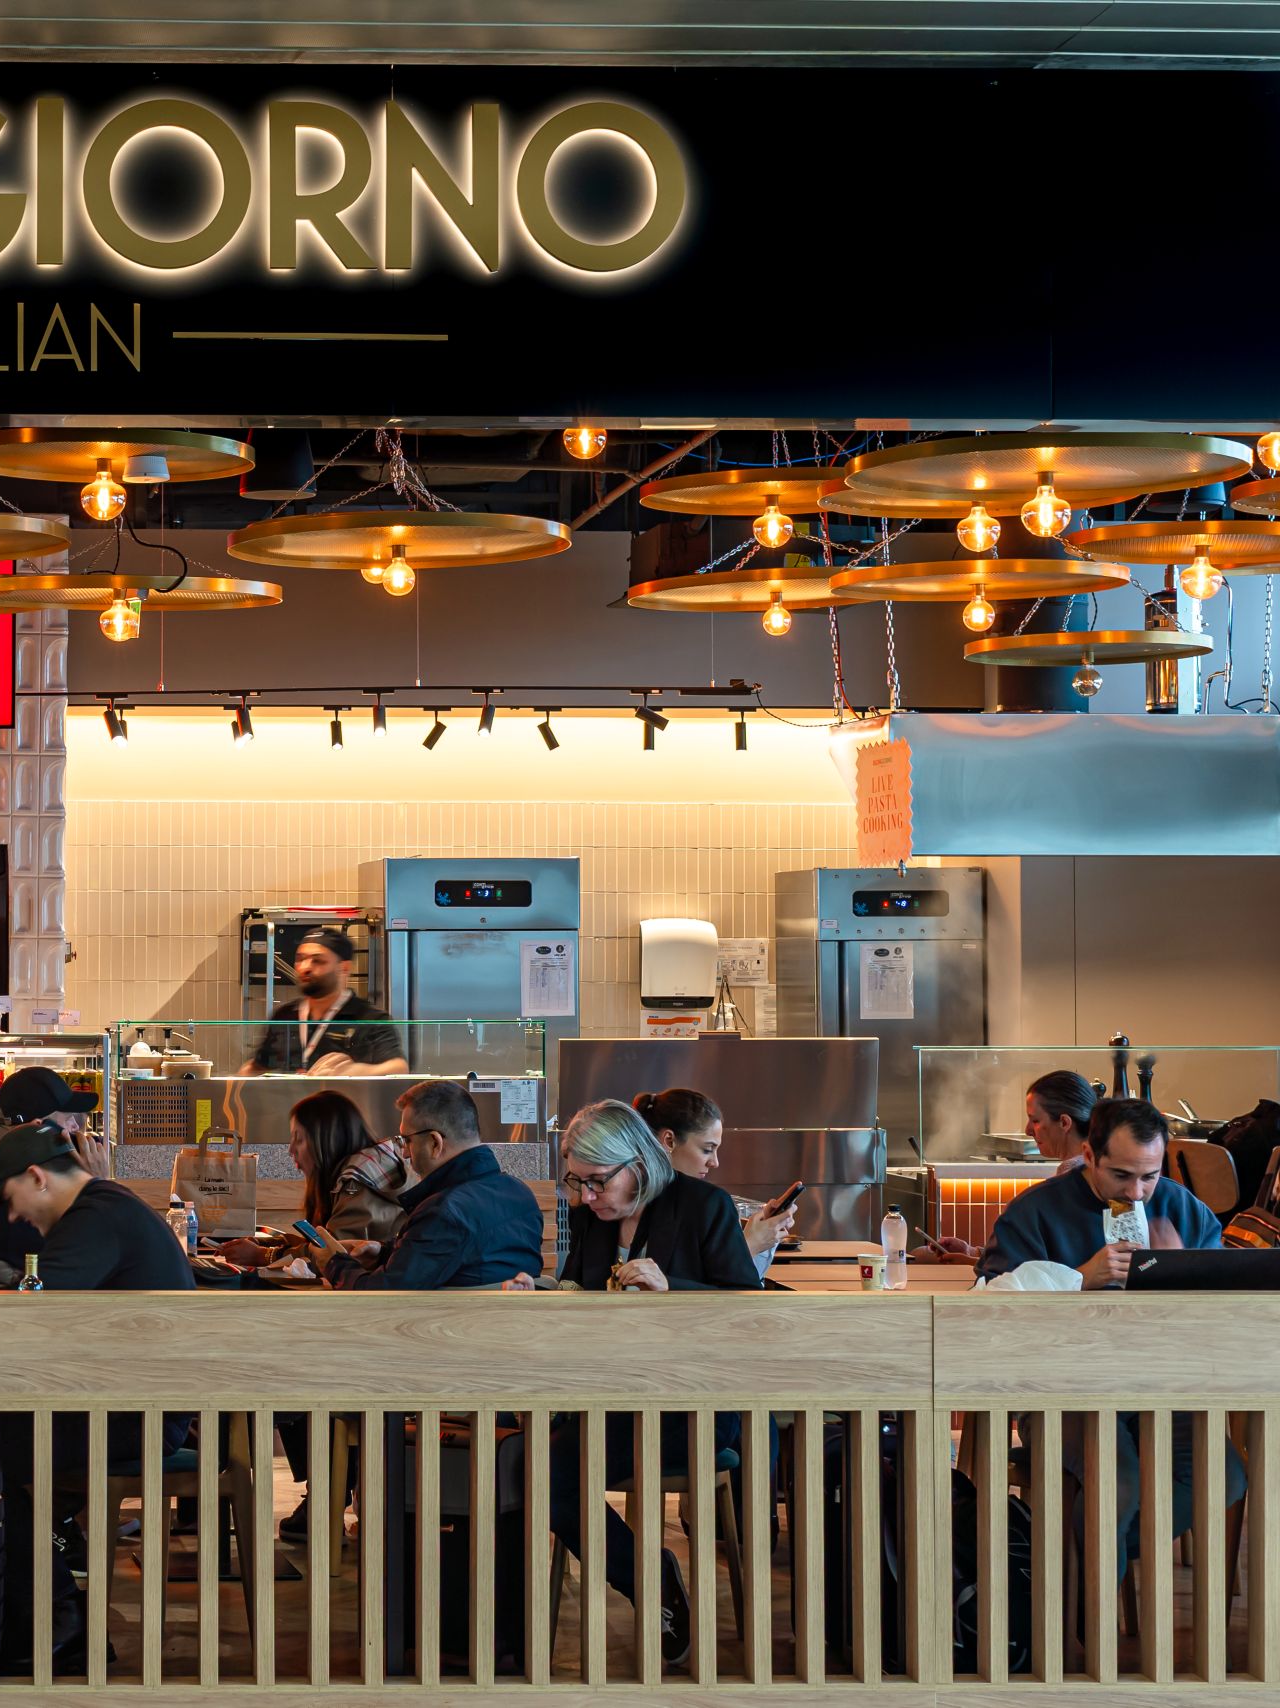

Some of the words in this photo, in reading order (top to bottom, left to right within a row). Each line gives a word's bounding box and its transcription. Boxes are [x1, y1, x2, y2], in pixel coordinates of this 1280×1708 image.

[871, 774, 893, 794] LIVE
[868, 793, 897, 814] PASTA
[863, 812, 903, 834] COOKING
